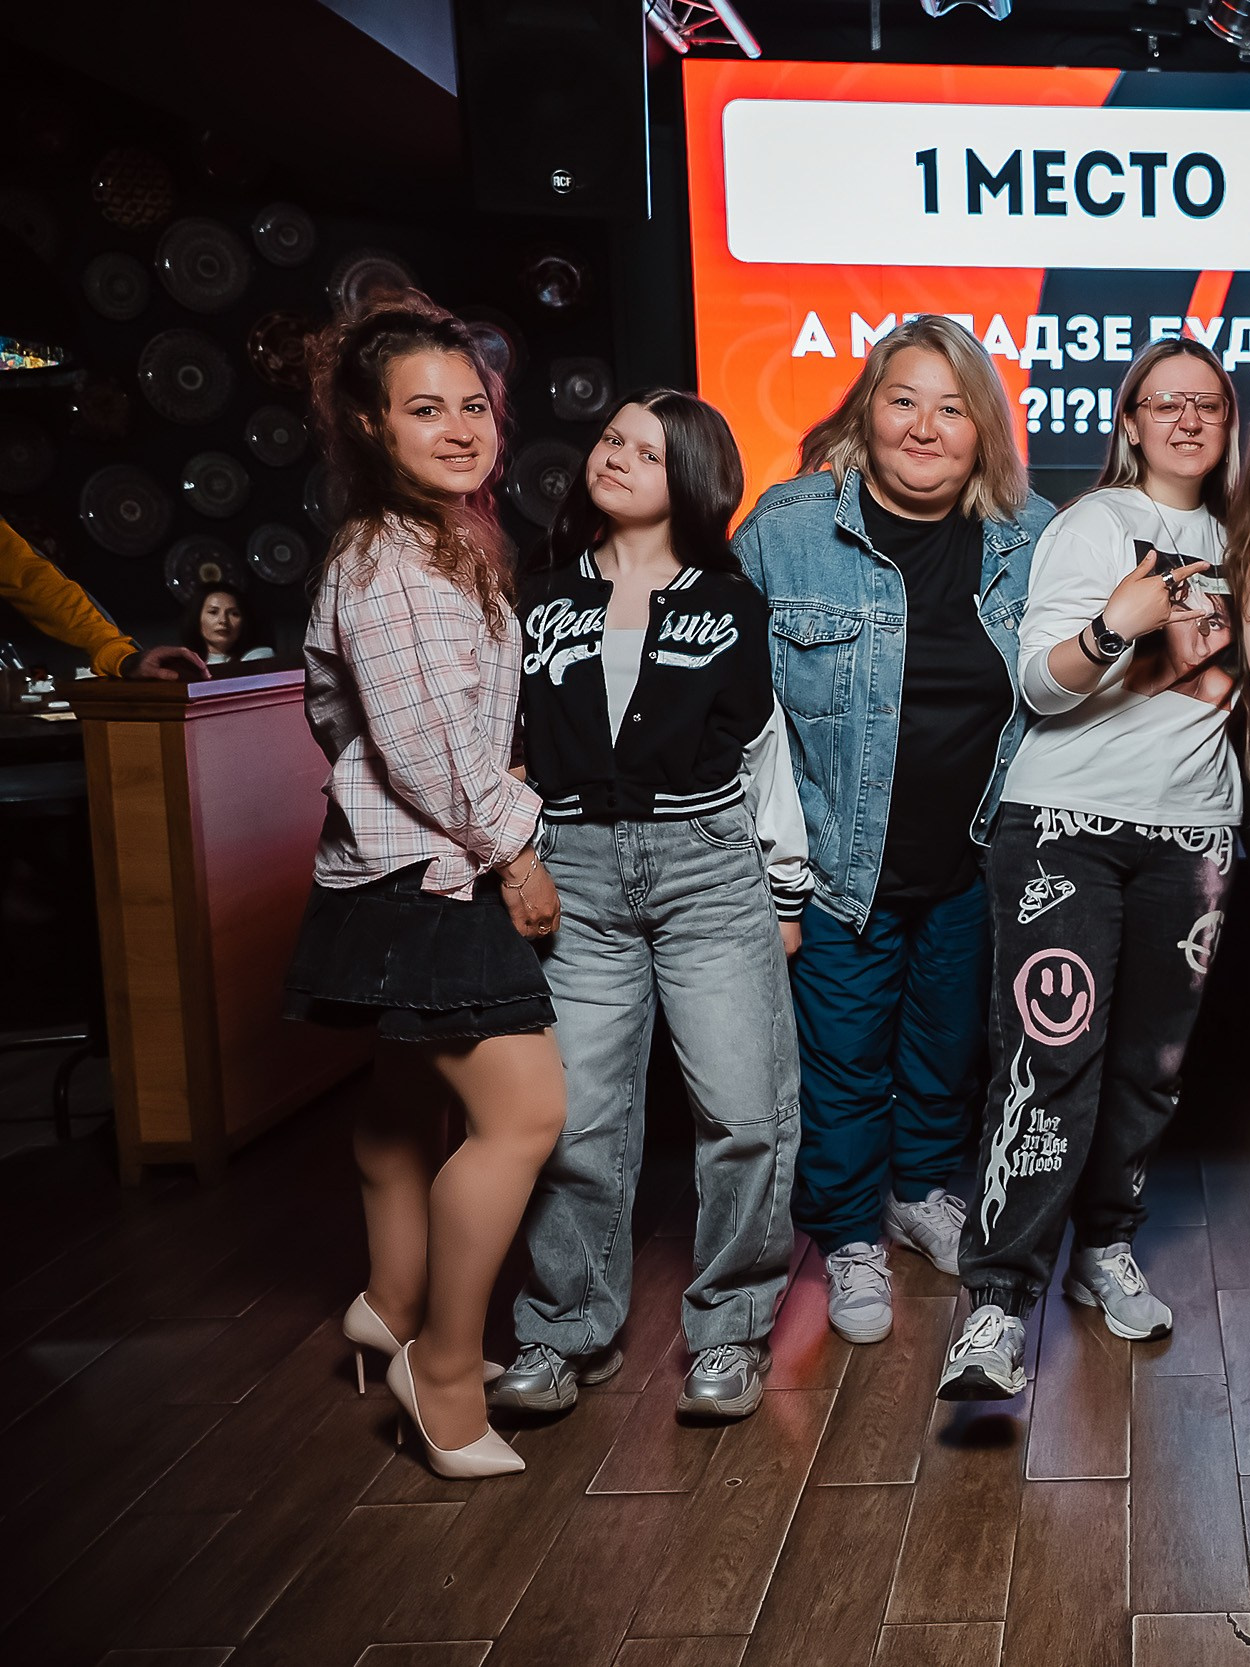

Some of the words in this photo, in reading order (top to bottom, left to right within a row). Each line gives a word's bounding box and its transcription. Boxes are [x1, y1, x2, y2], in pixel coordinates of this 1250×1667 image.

[553, 176, 571, 187] RCF
[916, 148, 939, 214] 1
[966, 148, 1227, 220] МЕСТО
[791, 310, 836, 358] А
[850, 312, 1133, 370] МАДЗЕ
[1010, 1148, 1063, 1177] Mood
